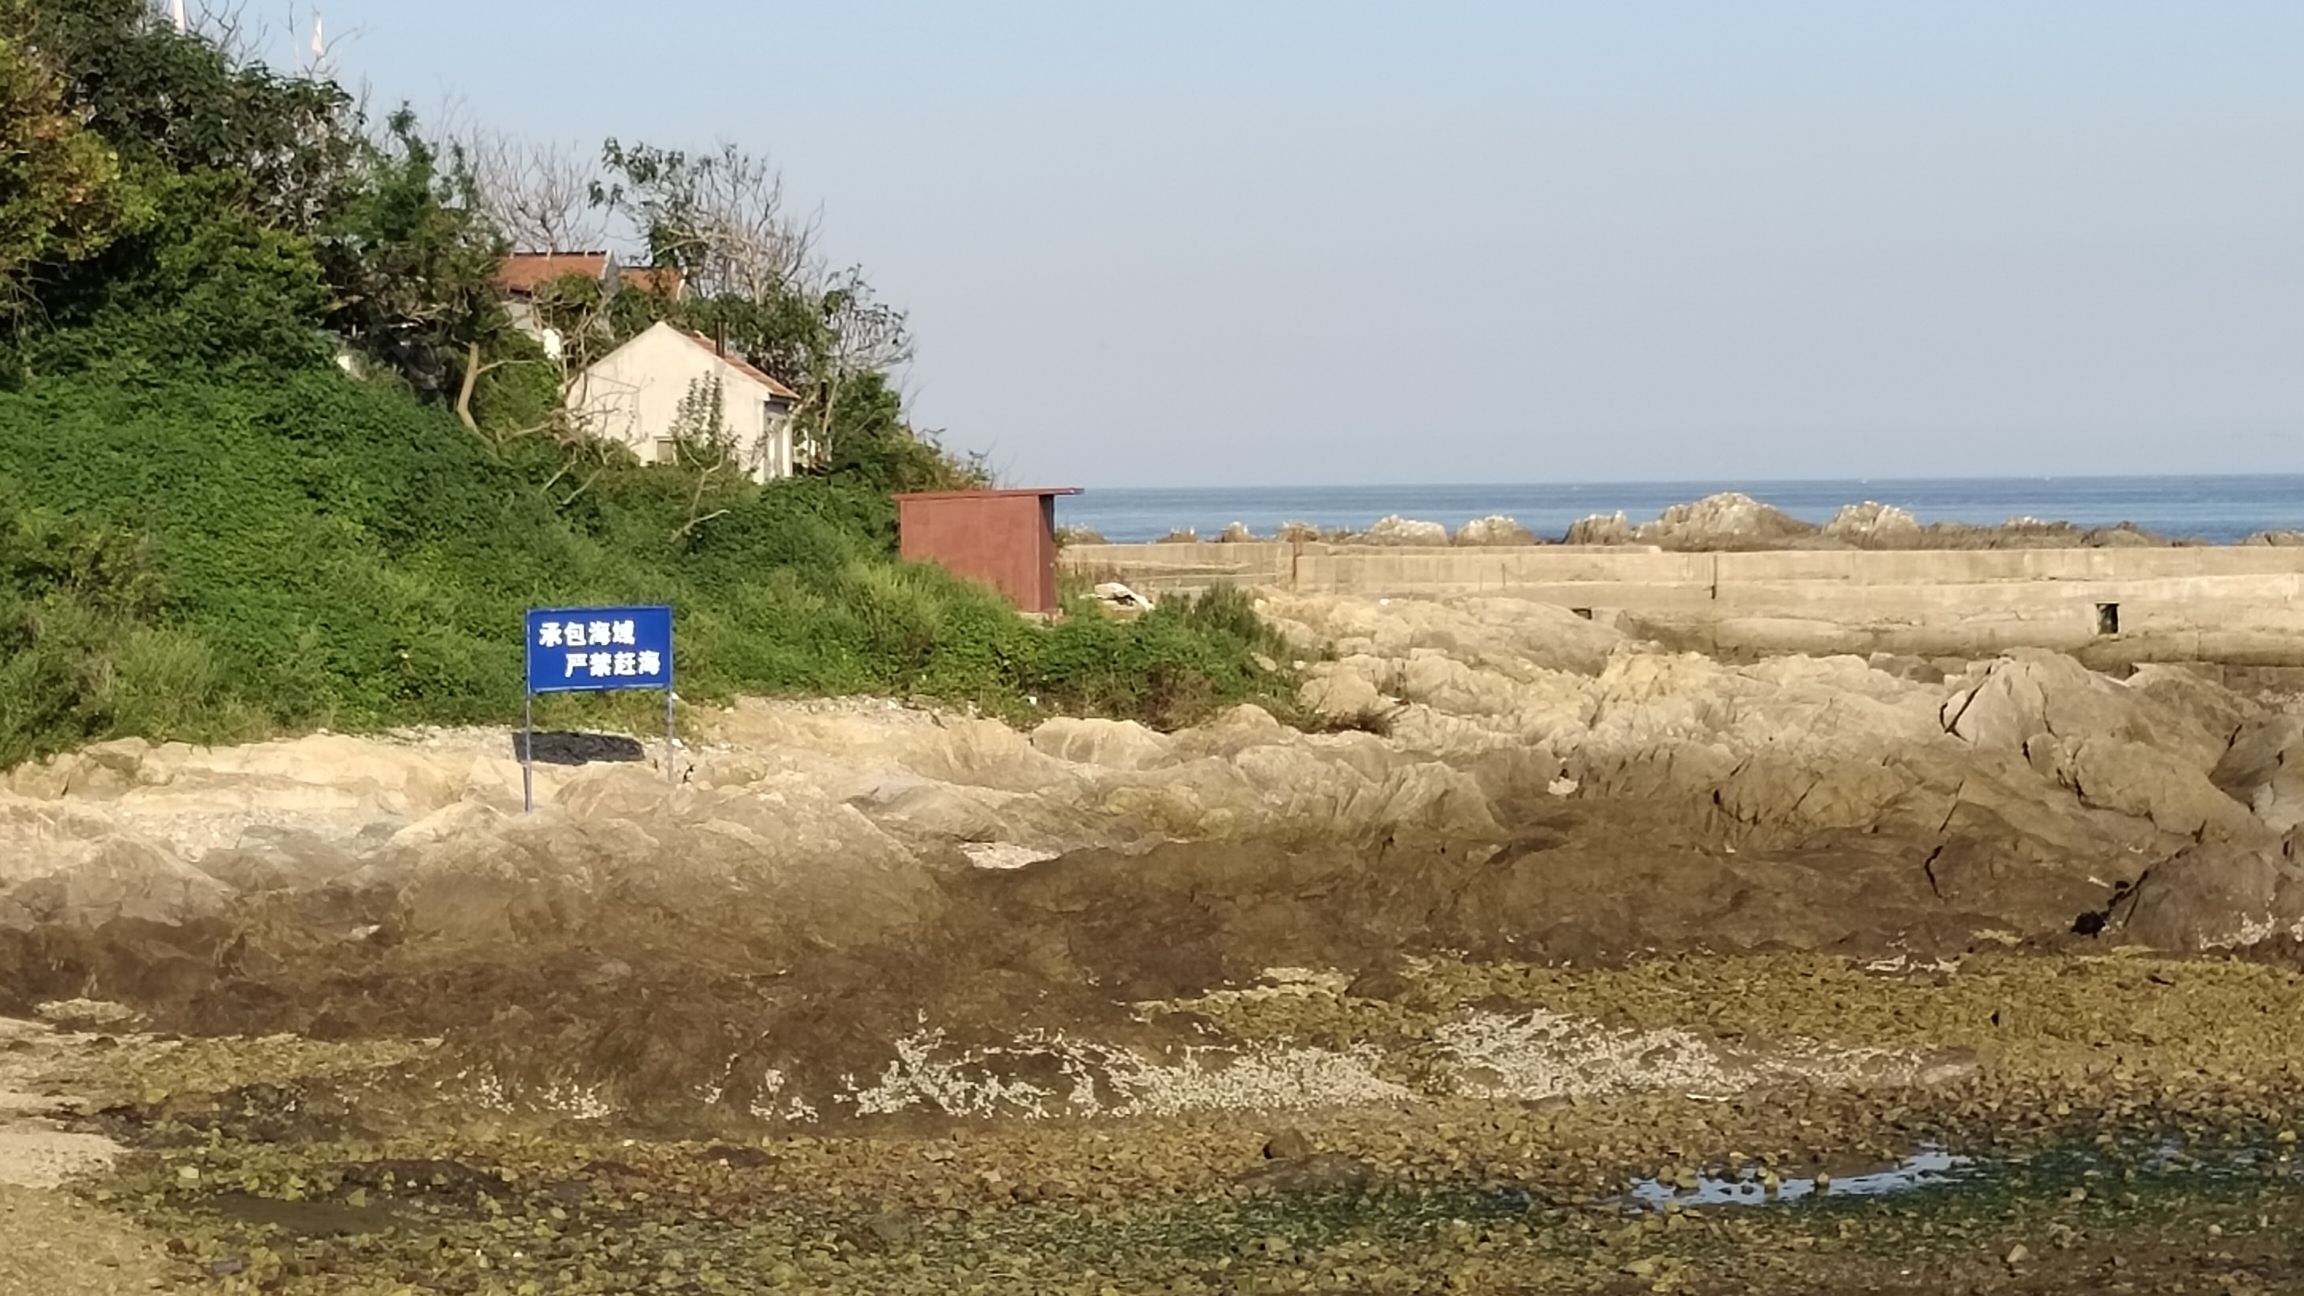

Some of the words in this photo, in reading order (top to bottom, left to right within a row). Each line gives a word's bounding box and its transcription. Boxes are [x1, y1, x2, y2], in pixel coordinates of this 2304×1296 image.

[539, 620, 635, 647] 承包海域
[564, 650, 660, 677] 严禁赶海
